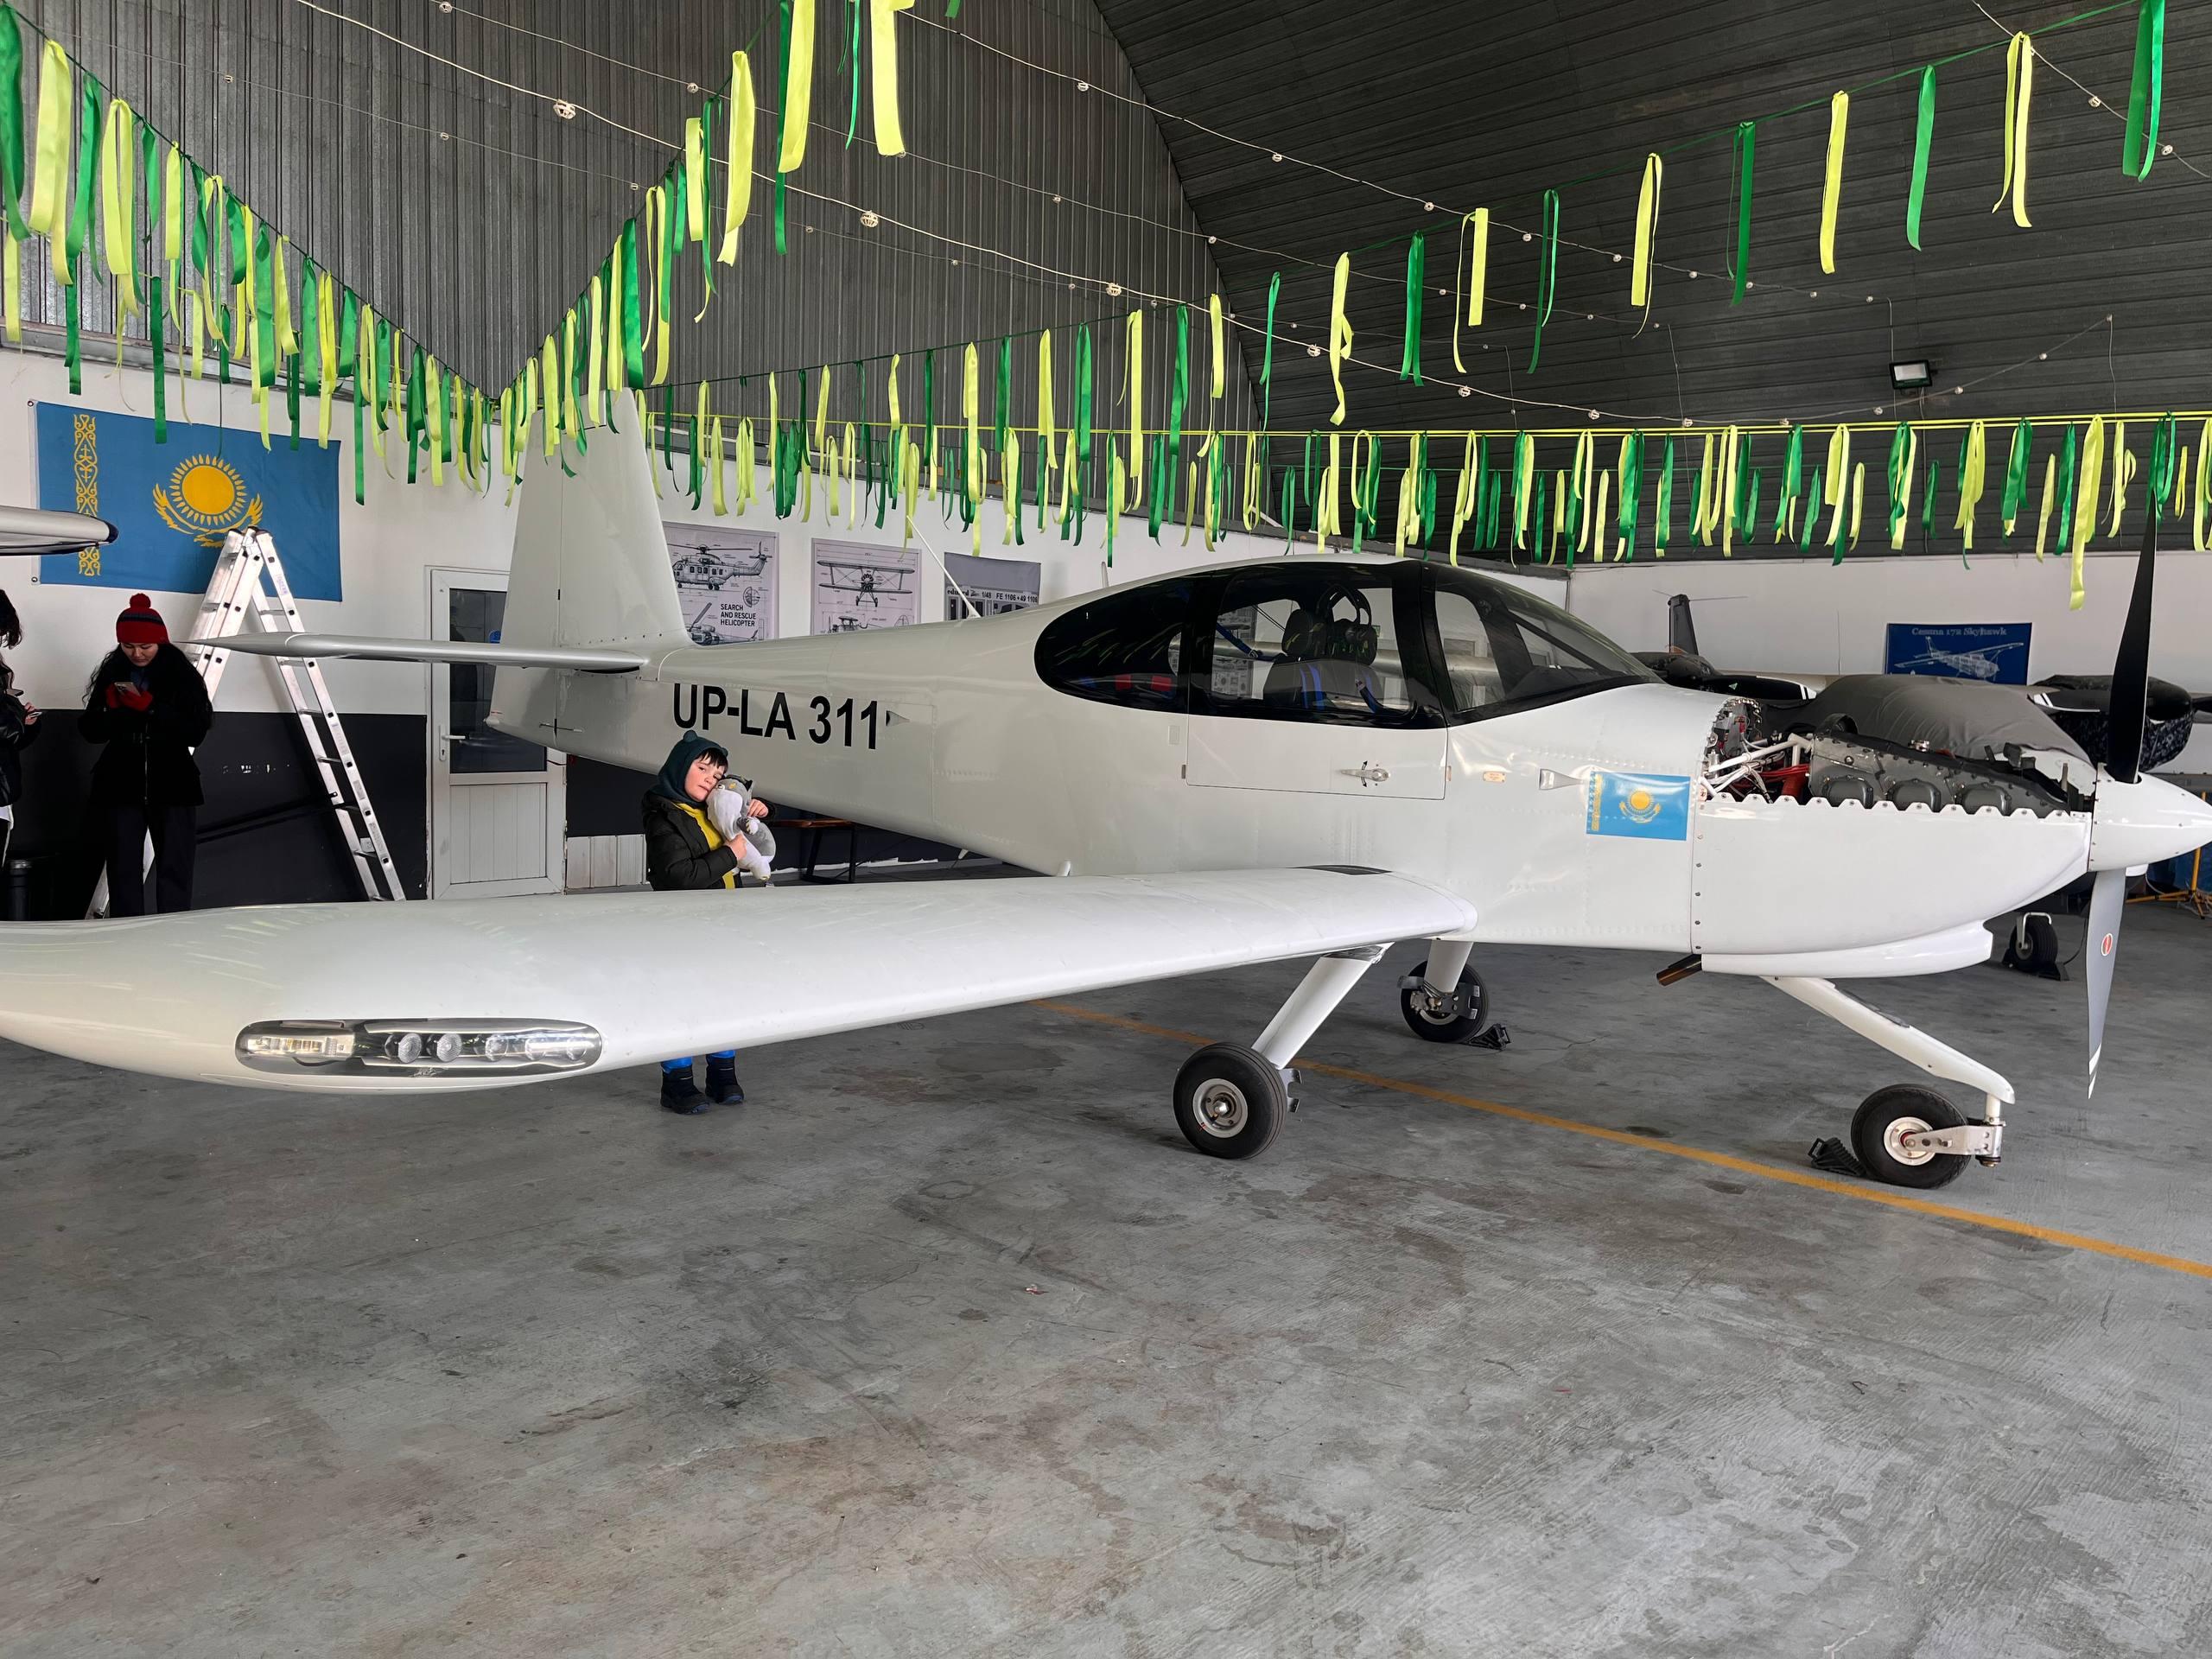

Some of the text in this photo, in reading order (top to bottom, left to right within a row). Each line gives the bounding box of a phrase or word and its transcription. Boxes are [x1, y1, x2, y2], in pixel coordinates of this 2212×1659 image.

[1005, 593, 1017, 601] 1106
[1911, 627, 1944, 636] Cessna
[1963, 626, 2007, 637] Skyhawk
[673, 683, 878, 750] UP-LA 311
